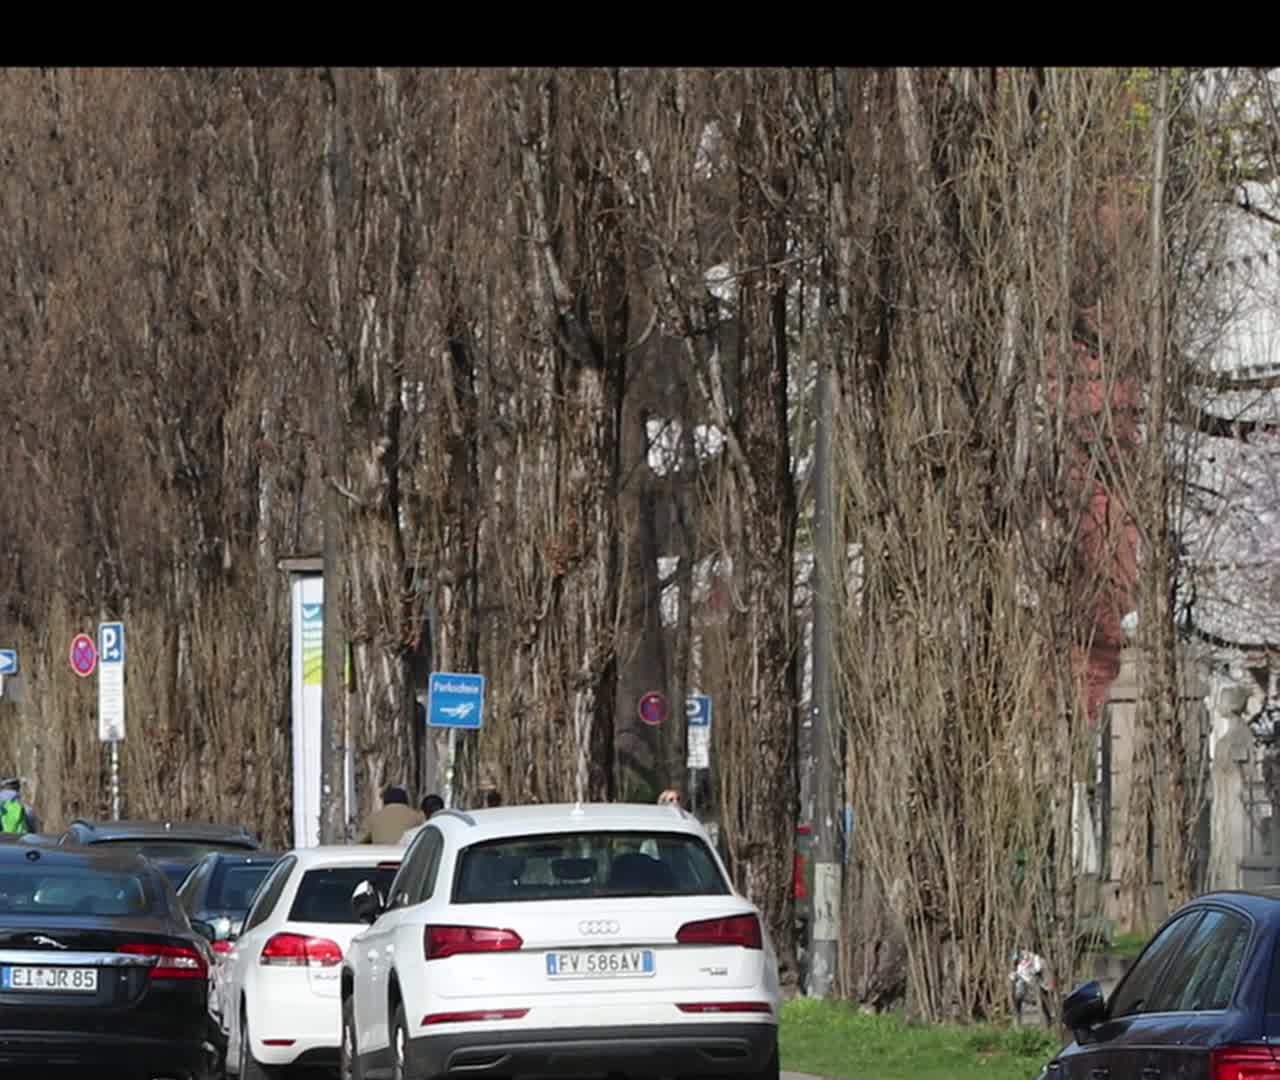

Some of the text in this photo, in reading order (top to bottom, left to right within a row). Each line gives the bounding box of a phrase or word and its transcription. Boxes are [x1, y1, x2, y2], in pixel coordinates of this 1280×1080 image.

[102, 628, 116, 659] P
[558, 952, 640, 971] FV 586AV
[12, 968, 95, 988] EI JR 85
